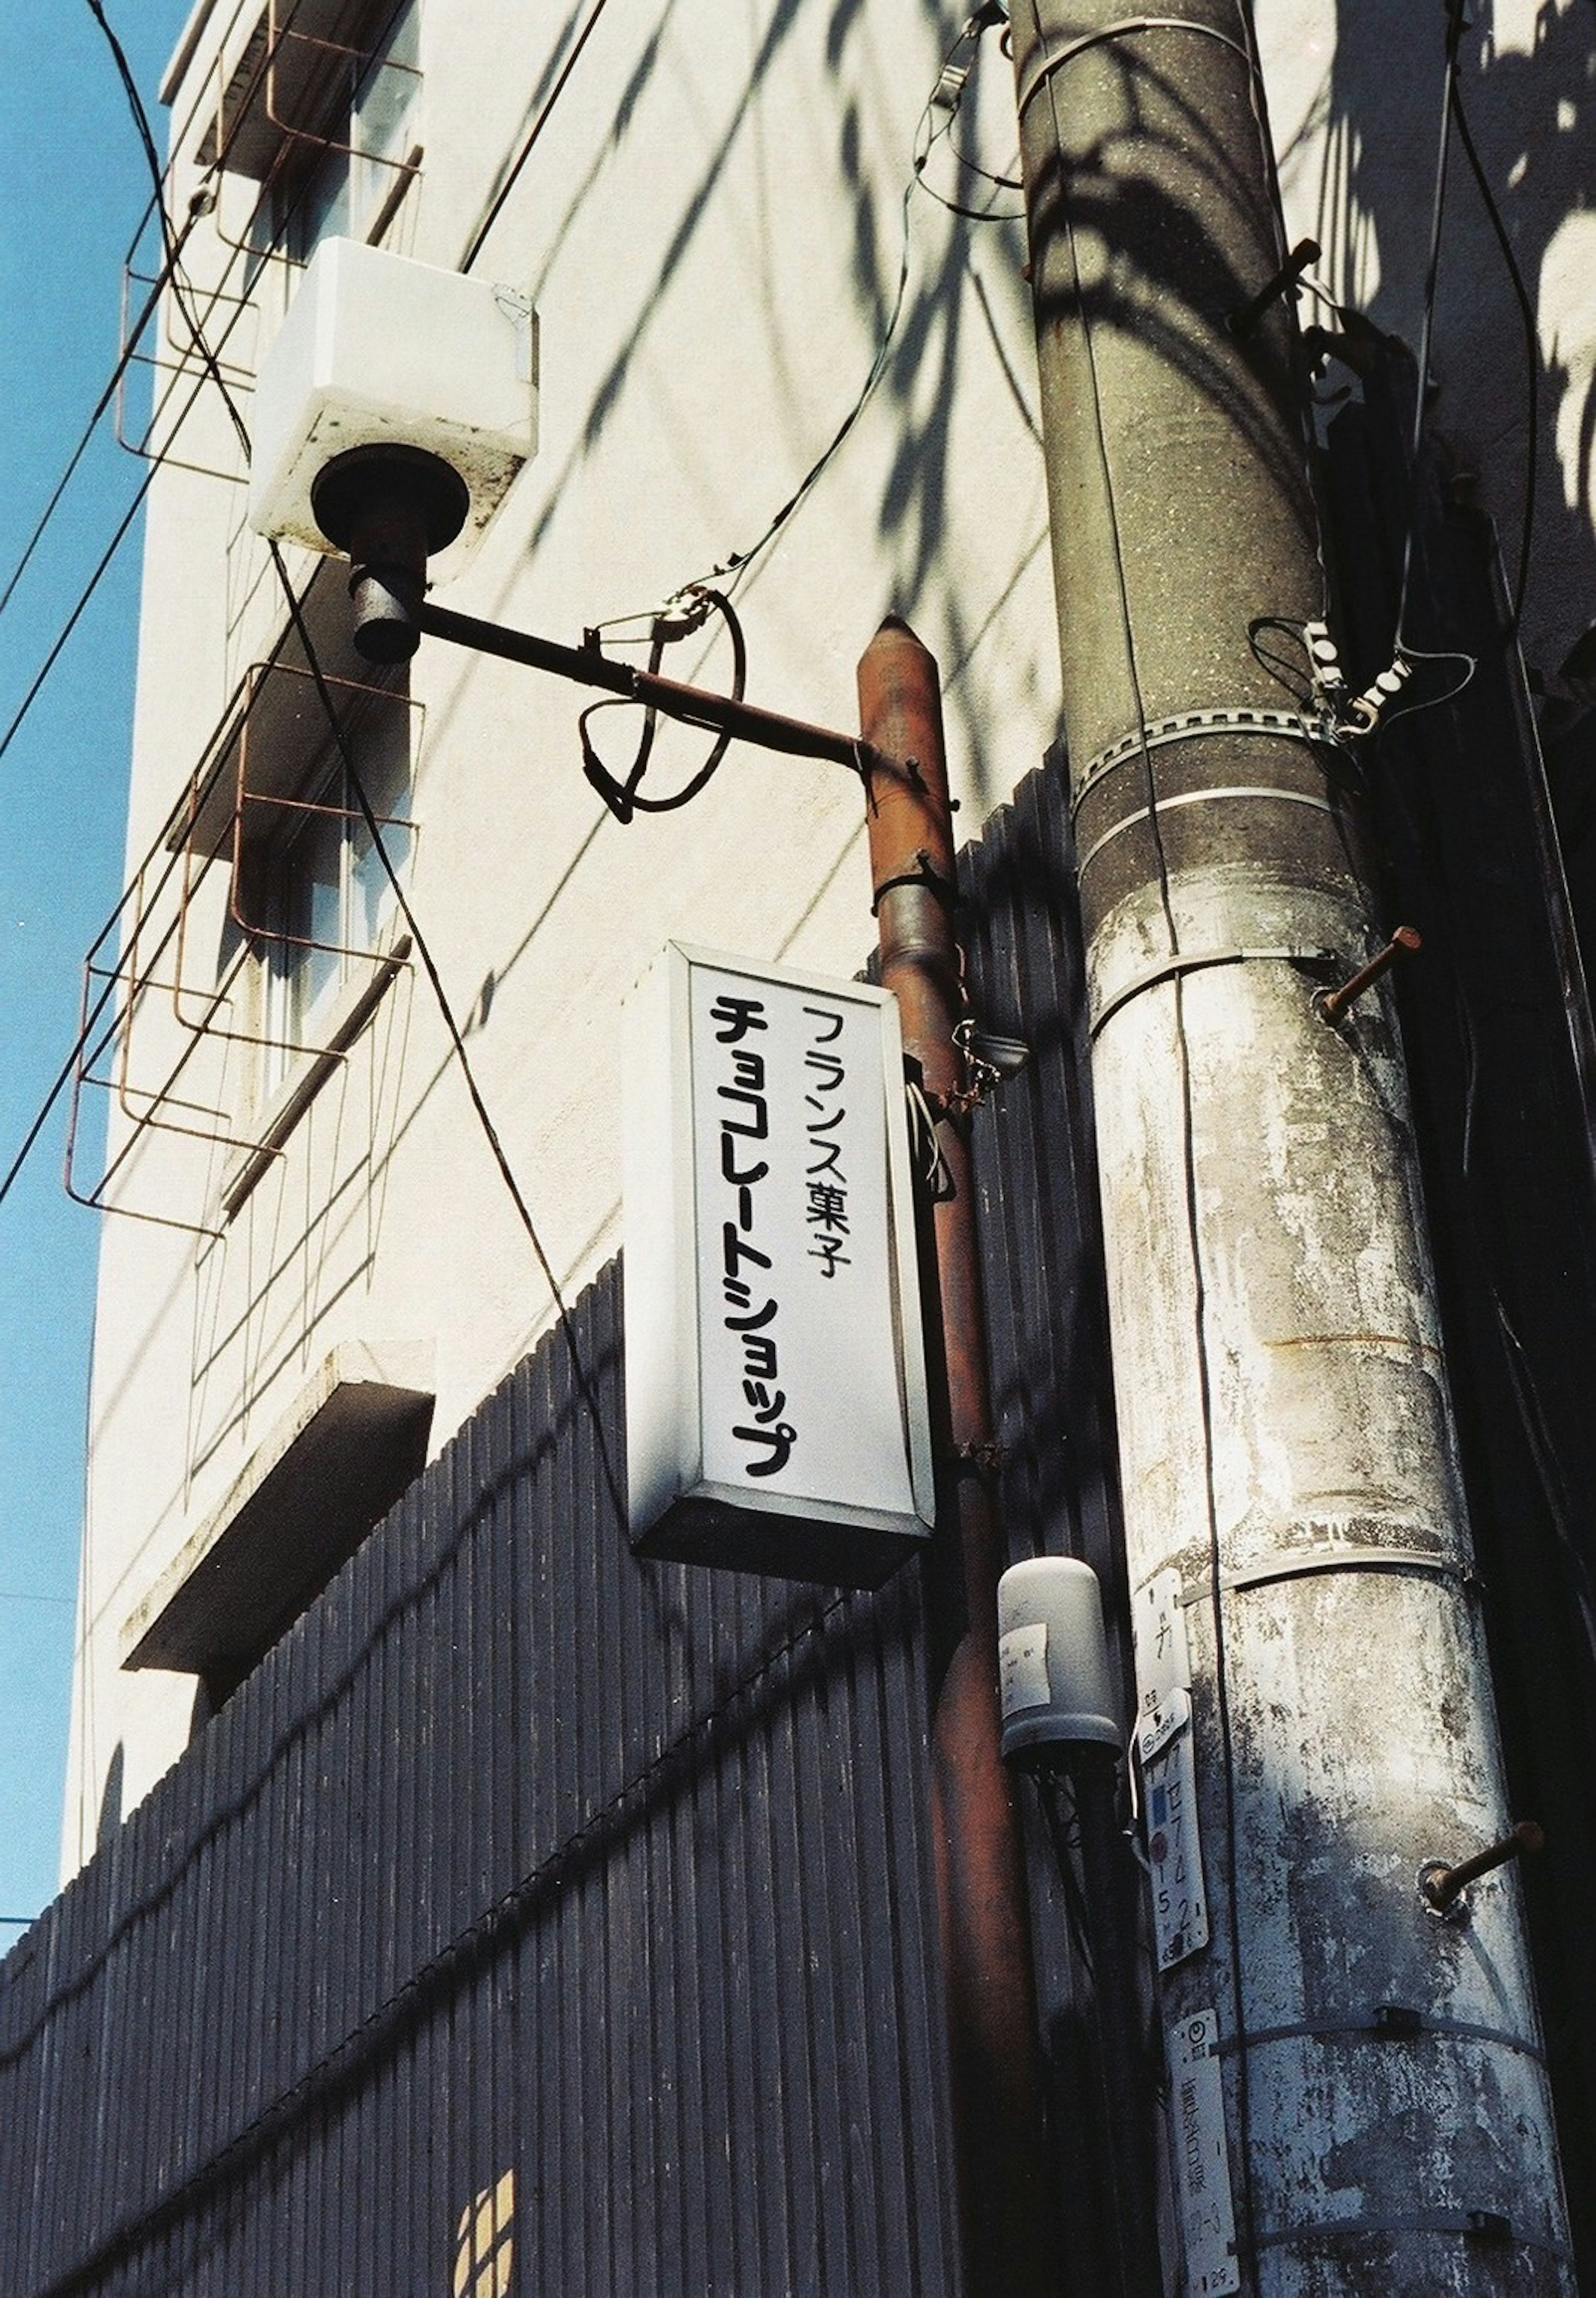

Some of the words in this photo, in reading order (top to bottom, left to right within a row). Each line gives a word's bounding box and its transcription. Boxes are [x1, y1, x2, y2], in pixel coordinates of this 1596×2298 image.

[710, 996, 797, 1477] チョコレートショップ
[803, 1007, 851, 1278] フランス菓子
